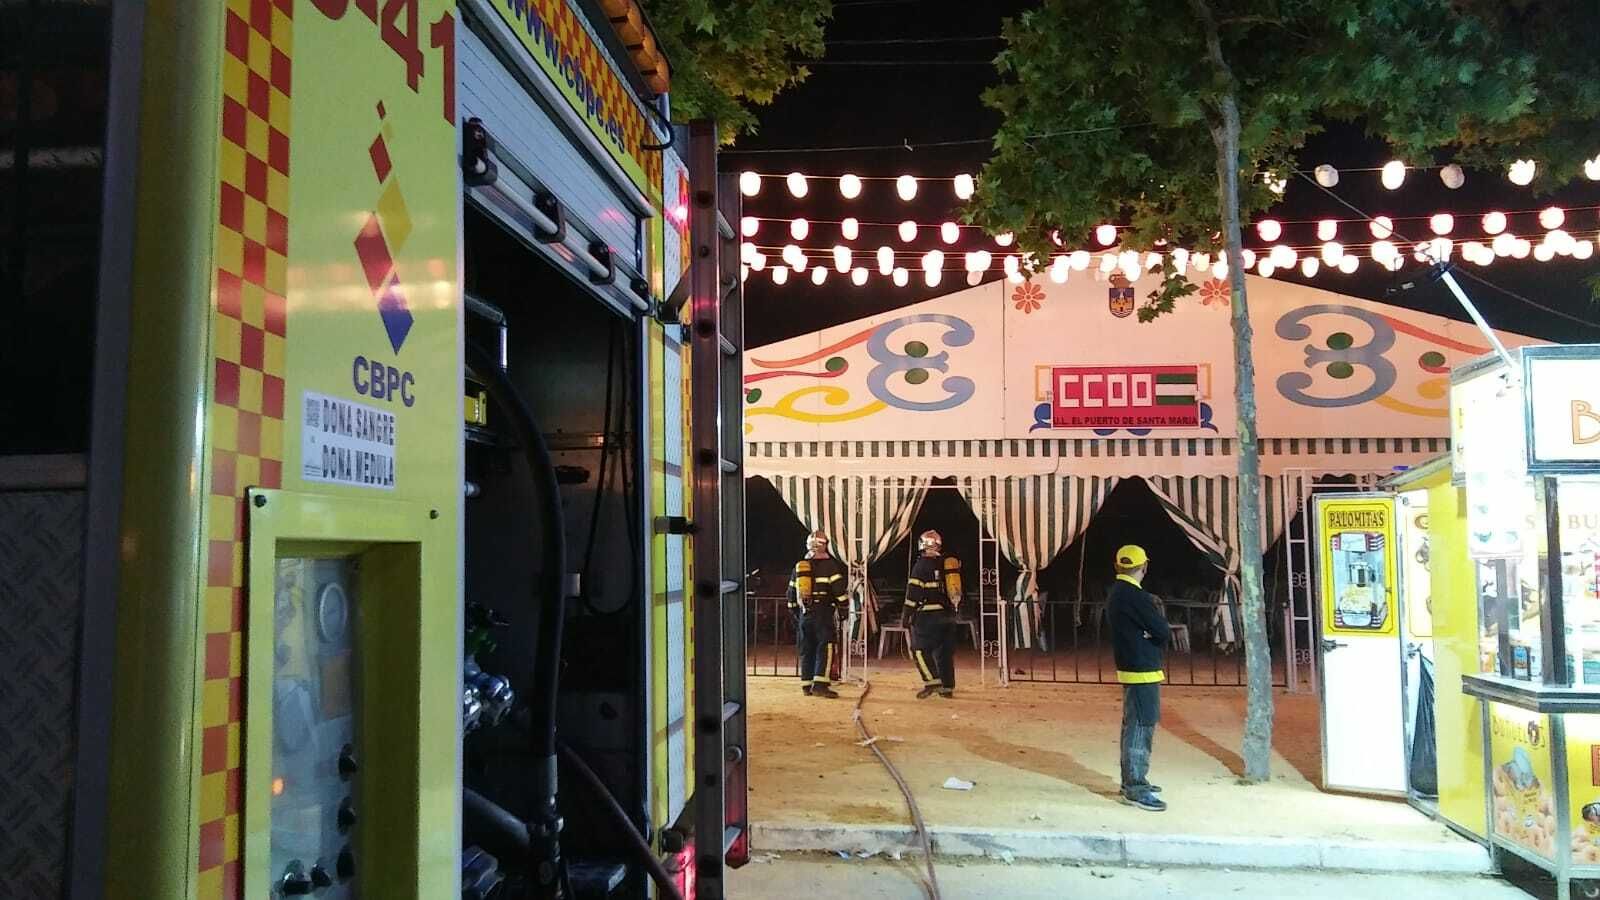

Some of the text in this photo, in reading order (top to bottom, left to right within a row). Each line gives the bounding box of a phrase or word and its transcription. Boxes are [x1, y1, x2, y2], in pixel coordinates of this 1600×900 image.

[353, 355, 415, 407] CBPC
[1059, 374, 1152, 407] CCOO
[323, 399, 394, 446] DONA SANGRE
[1072, 416, 1083, 425] EL
[1084, 416, 1120, 425] PUERTO
[1122, 416, 1134, 425] DE
[1136, 416, 1167, 425] SANTA
[1168, 416, 1198, 425] MARIA
[322, 444, 394, 486] DONA MEDULA
[1329, 511, 1385, 528] PALOMITAS
